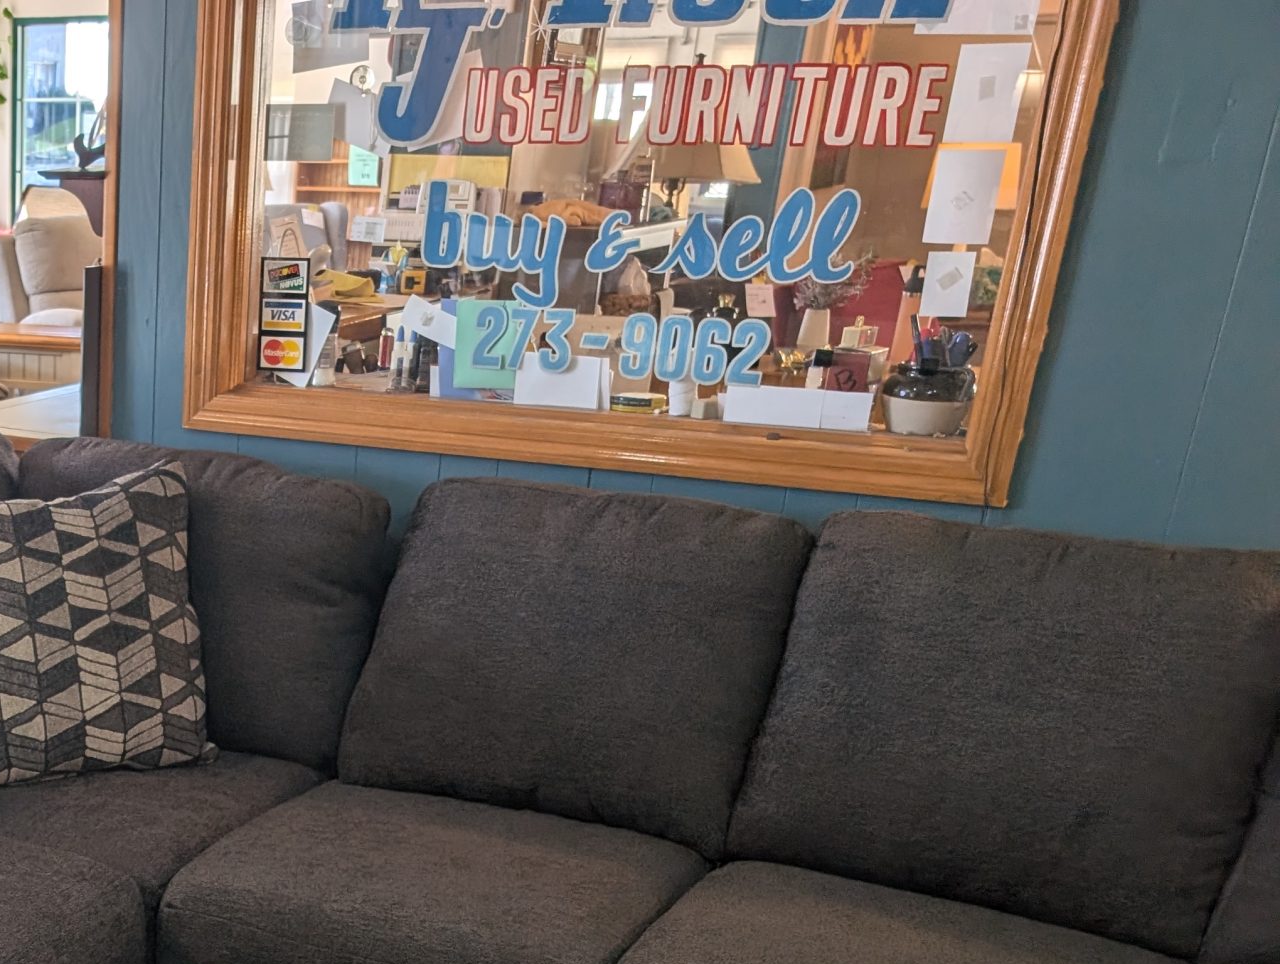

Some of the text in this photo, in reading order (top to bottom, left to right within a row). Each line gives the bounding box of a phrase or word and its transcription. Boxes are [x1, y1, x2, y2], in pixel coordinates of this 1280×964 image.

[463, 63, 950, 147] USED FURNITURE
[422, 180, 862, 307] buy & sell
[279, 277, 303, 289] NOVUS
[270, 309, 297, 321] VISA
